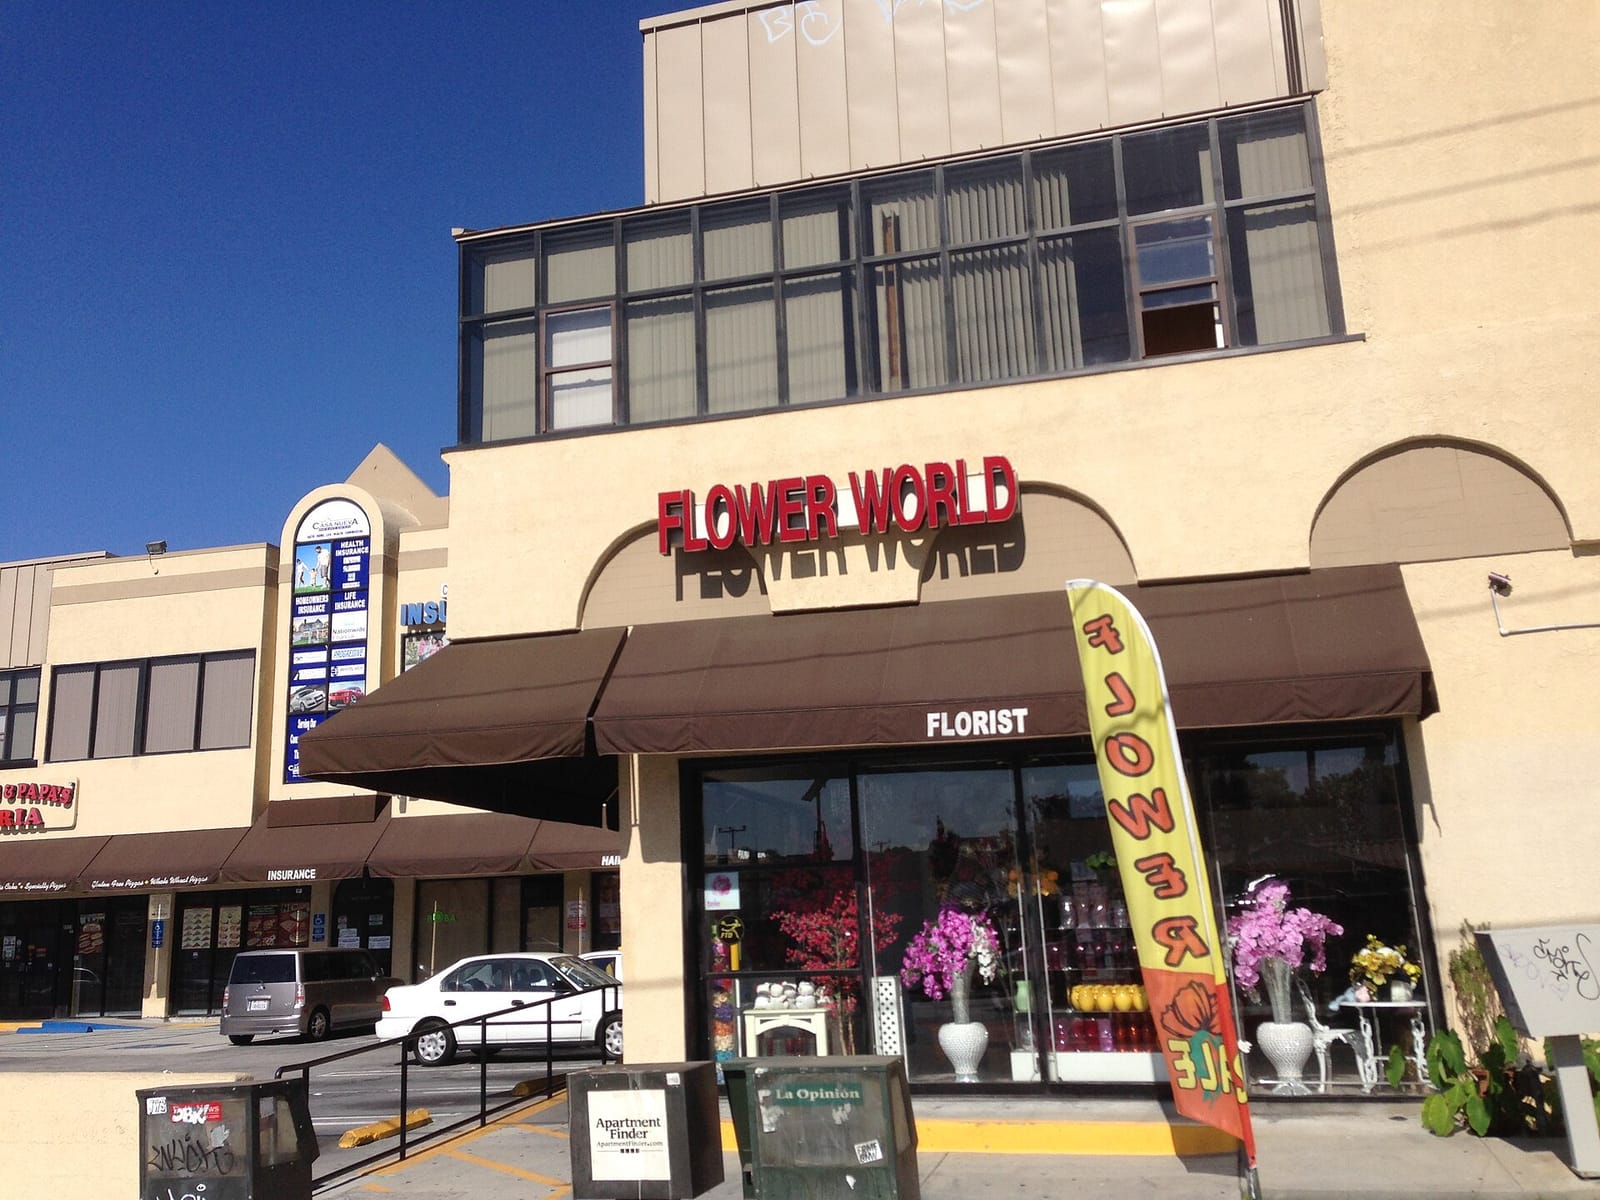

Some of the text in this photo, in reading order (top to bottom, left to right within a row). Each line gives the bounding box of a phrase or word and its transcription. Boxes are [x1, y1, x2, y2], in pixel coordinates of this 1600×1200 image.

[657, 455, 1018, 556] FLOWER WORLD
[340, 540, 364, 549] HEALTH
[335, 546, 369, 557] INSURANCE
[295, 594, 329, 606] HOMEOWNERS
[344, 591, 357, 601] LIFE
[297, 603, 326, 615] INSURANCE
[334, 599, 366, 611] INSURANCE
[926, 707, 1028, 737] FLORIST
[17, 783, 72, 804] PAPA'S
[190, 875, 208, 885] Pizzas
[267, 868, 316, 881] INSURANCE
[720, 931, 733, 939] FTD
[775, 1087, 861, 1102] La Opinión
[595, 1117, 661, 1132] Apartment
[609, 1128, 649, 1140] Finder
